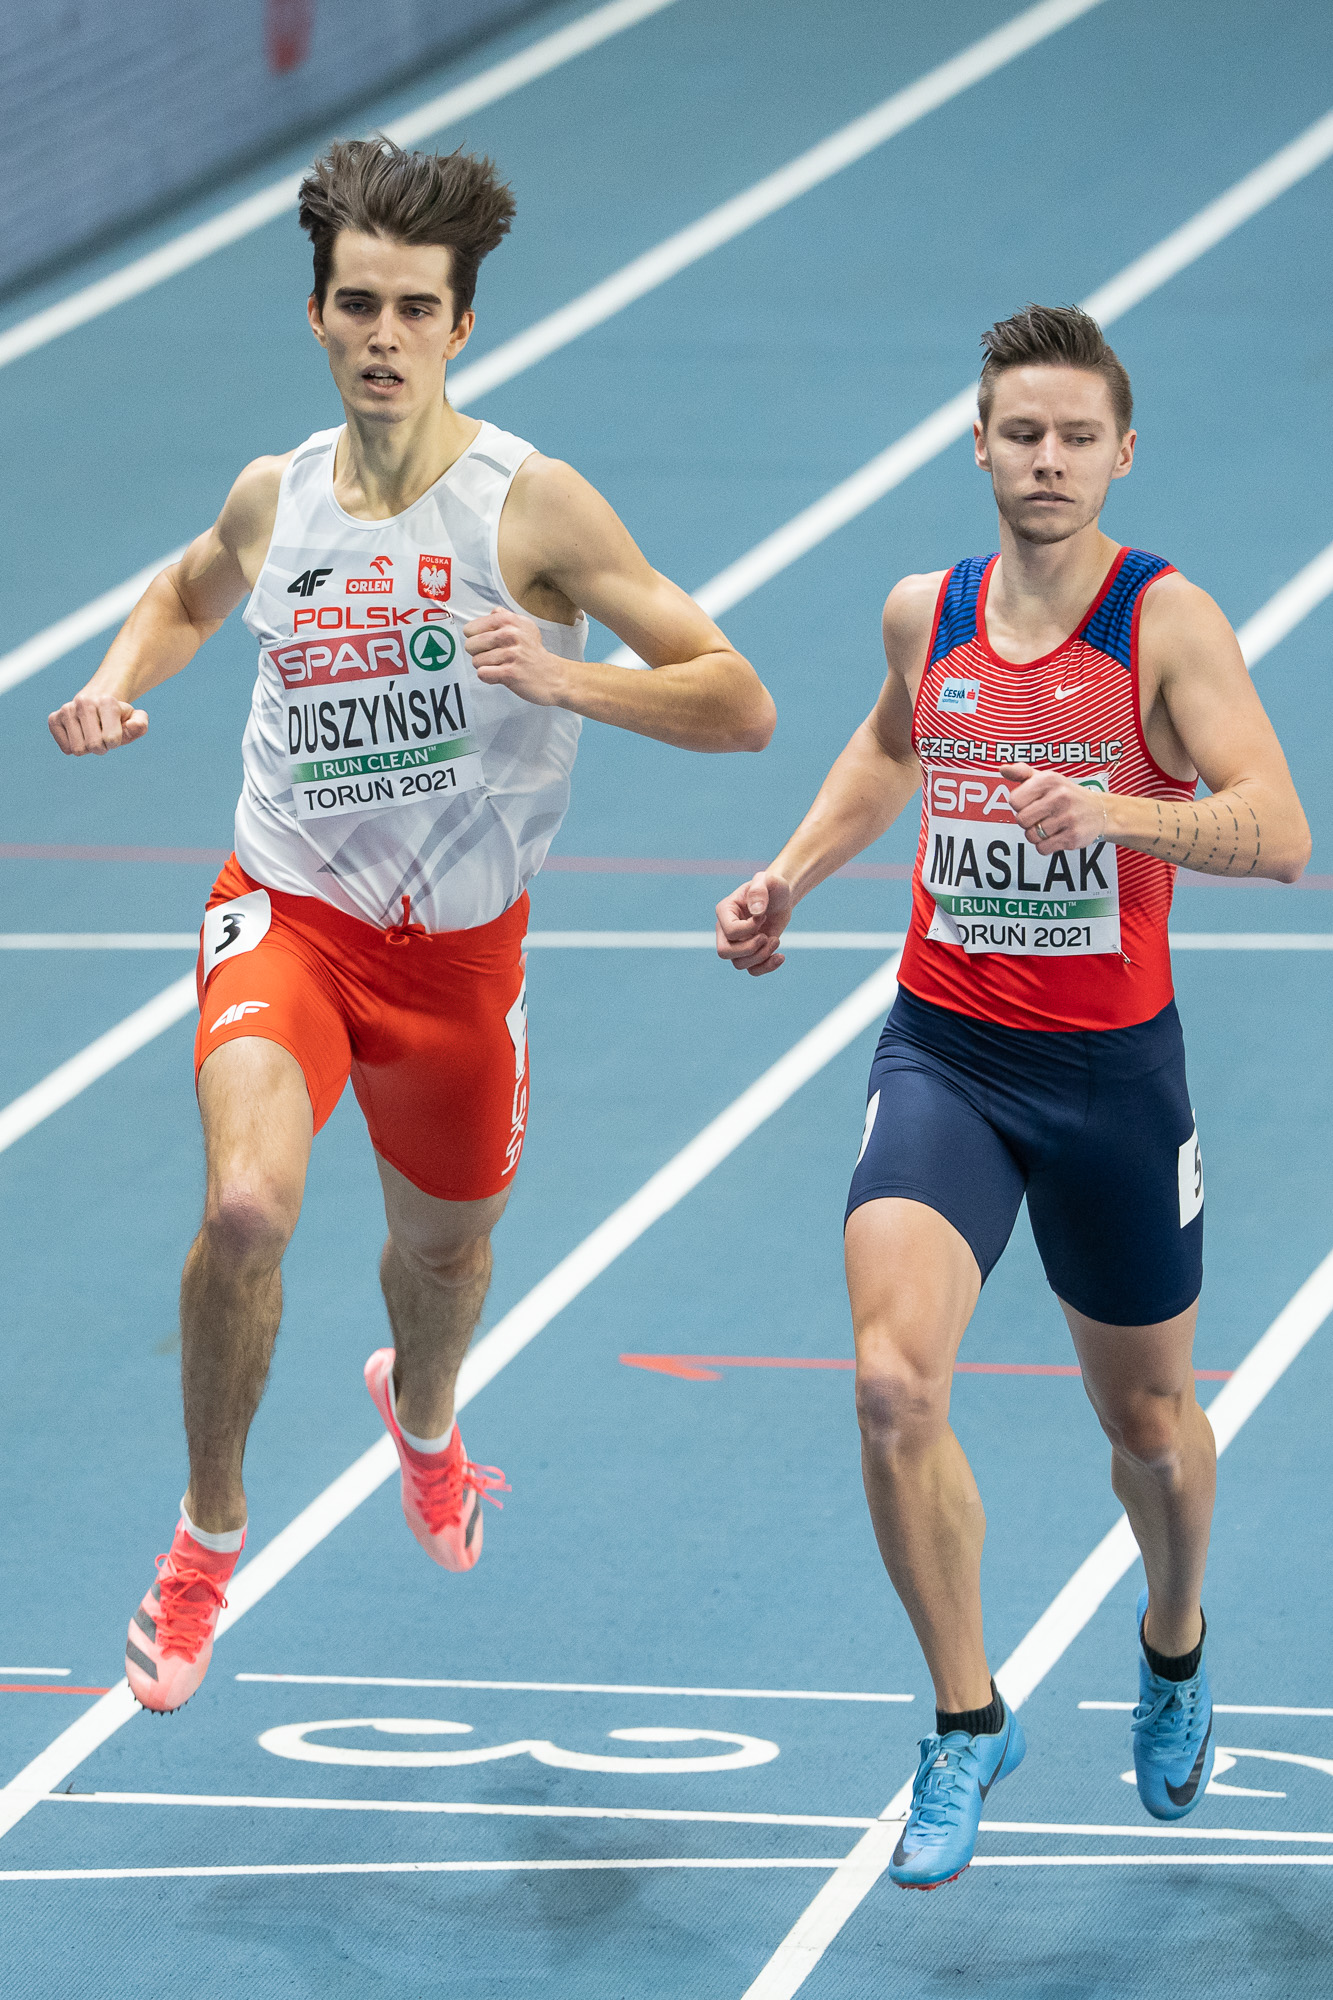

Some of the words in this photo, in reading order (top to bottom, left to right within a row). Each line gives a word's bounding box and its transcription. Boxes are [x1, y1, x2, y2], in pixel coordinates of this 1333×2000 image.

[421, 556, 449, 565] POLSKA
[287, 568, 334, 597] 4F
[348, 580, 391, 592] ORLEN
[277, 638, 404, 681] SPAR
[288, 681, 467, 755] DUSZYŃSKI
[918, 737, 987, 761] CZECH
[995, 741, 1123, 764] REPUBLIC
[323, 757, 363, 777] RUN
[304, 777, 394, 810] TORUŃ
[400, 767, 457, 797] 2021
[933, 778, 1013, 815] SPA
[960, 898, 1000, 914] RUN
[215, 913, 246, 955] 3
[957, 923, 1026, 947] ORUŃ
[1034, 926, 1091, 948] 2021
[258, 1718, 780, 1774] 3
